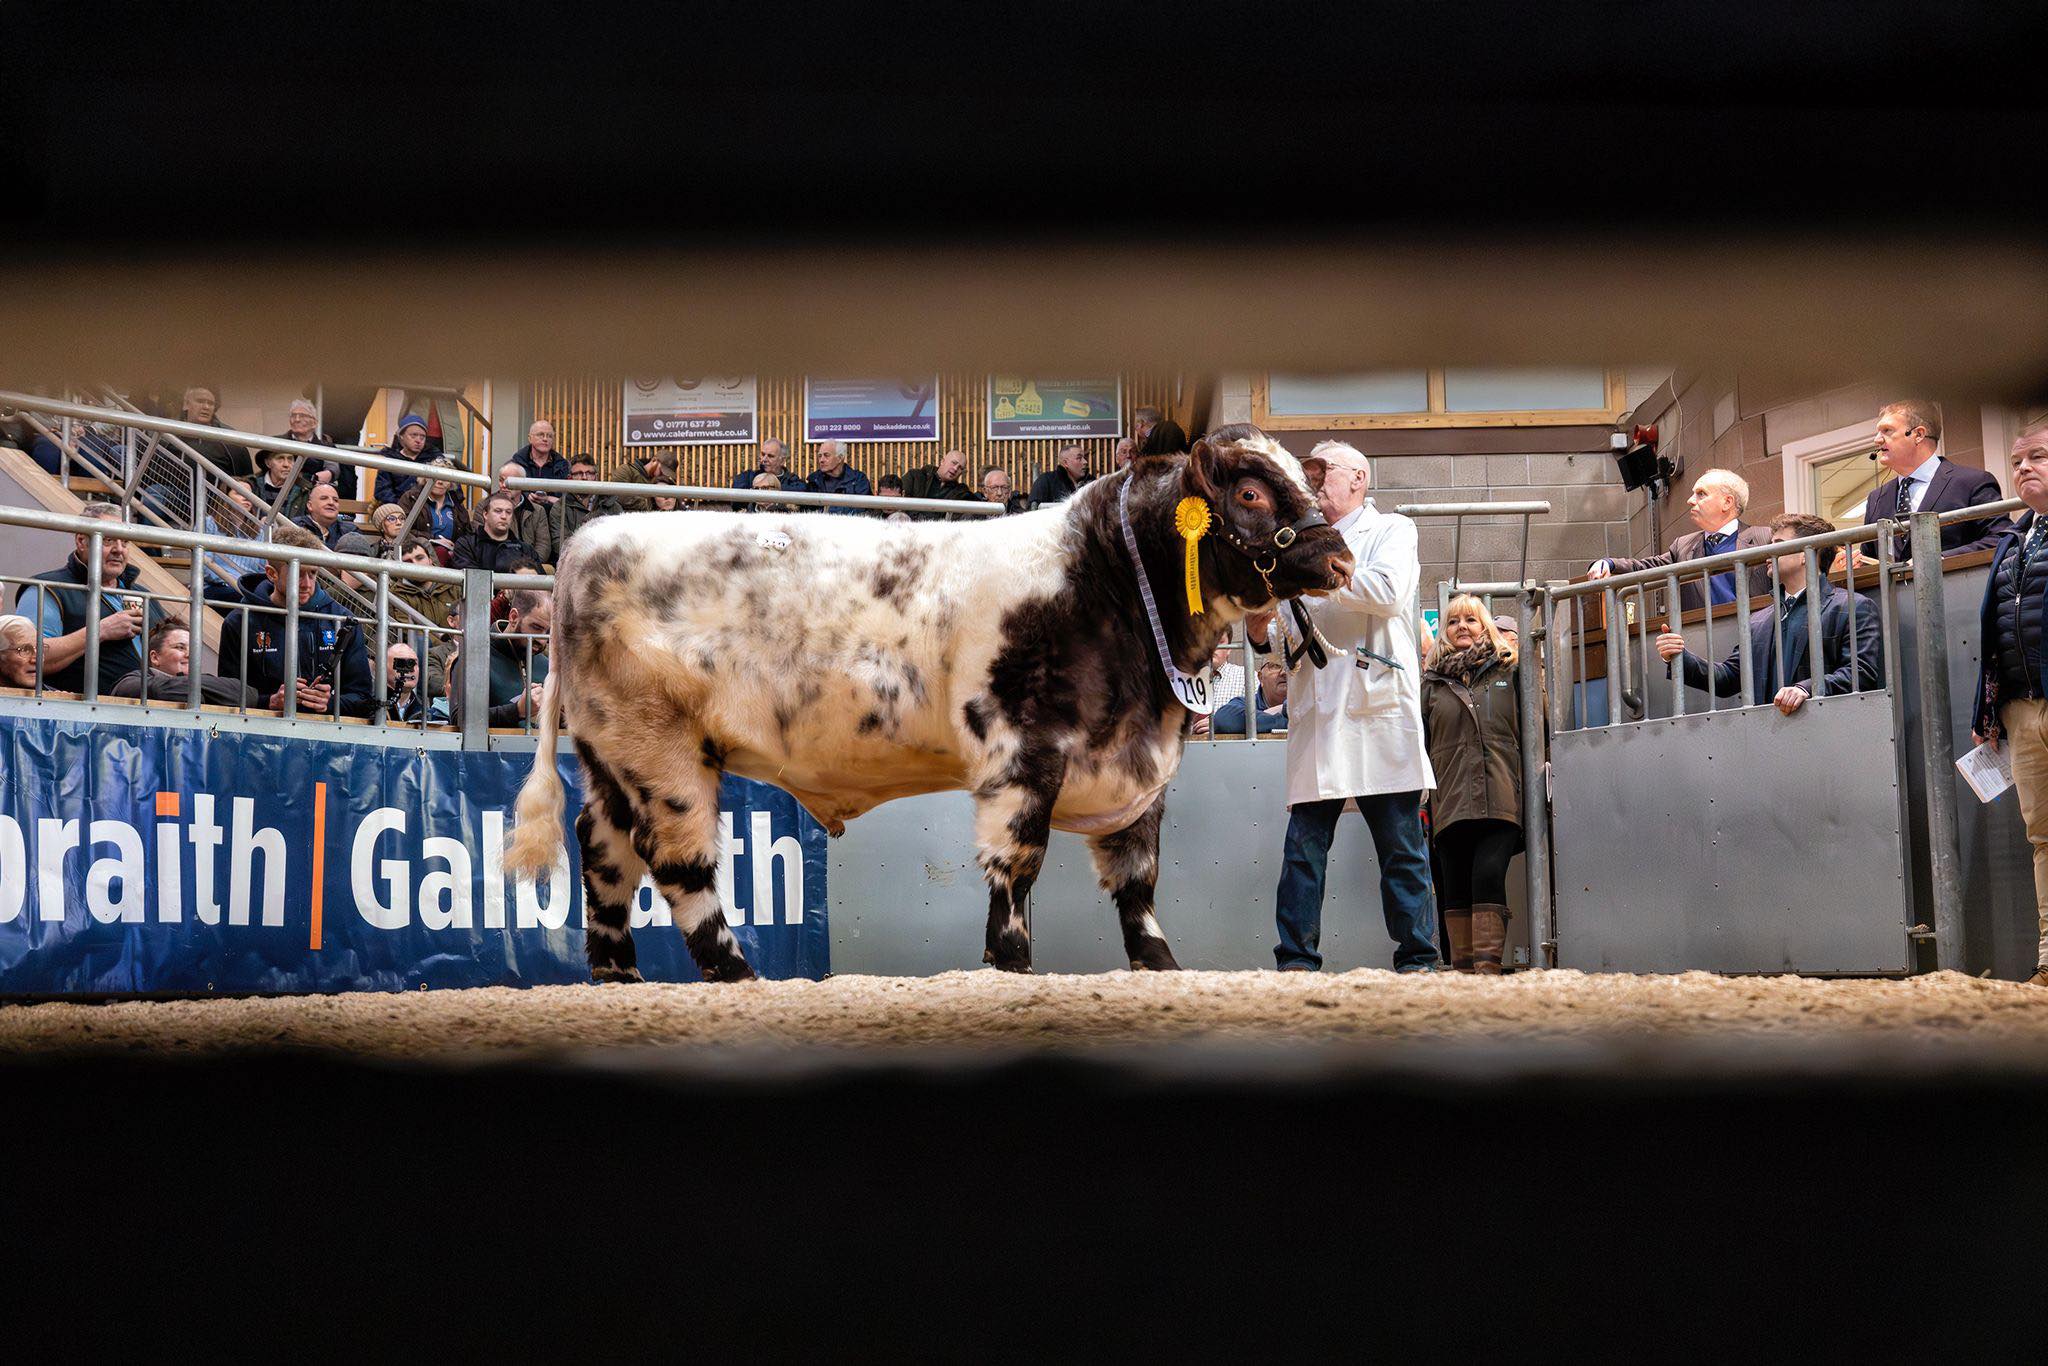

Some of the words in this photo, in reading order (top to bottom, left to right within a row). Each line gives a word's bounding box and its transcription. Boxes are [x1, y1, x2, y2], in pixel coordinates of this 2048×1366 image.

[665, 421, 688, 429] 01771
[689, 420, 705, 428] 637
[706, 420, 720, 428] 219
[814, 424, 829, 432] 0131
[643, 429, 748, 438] www.calefarmvets.co.uk
[1177, 676, 1208, 706] 219
